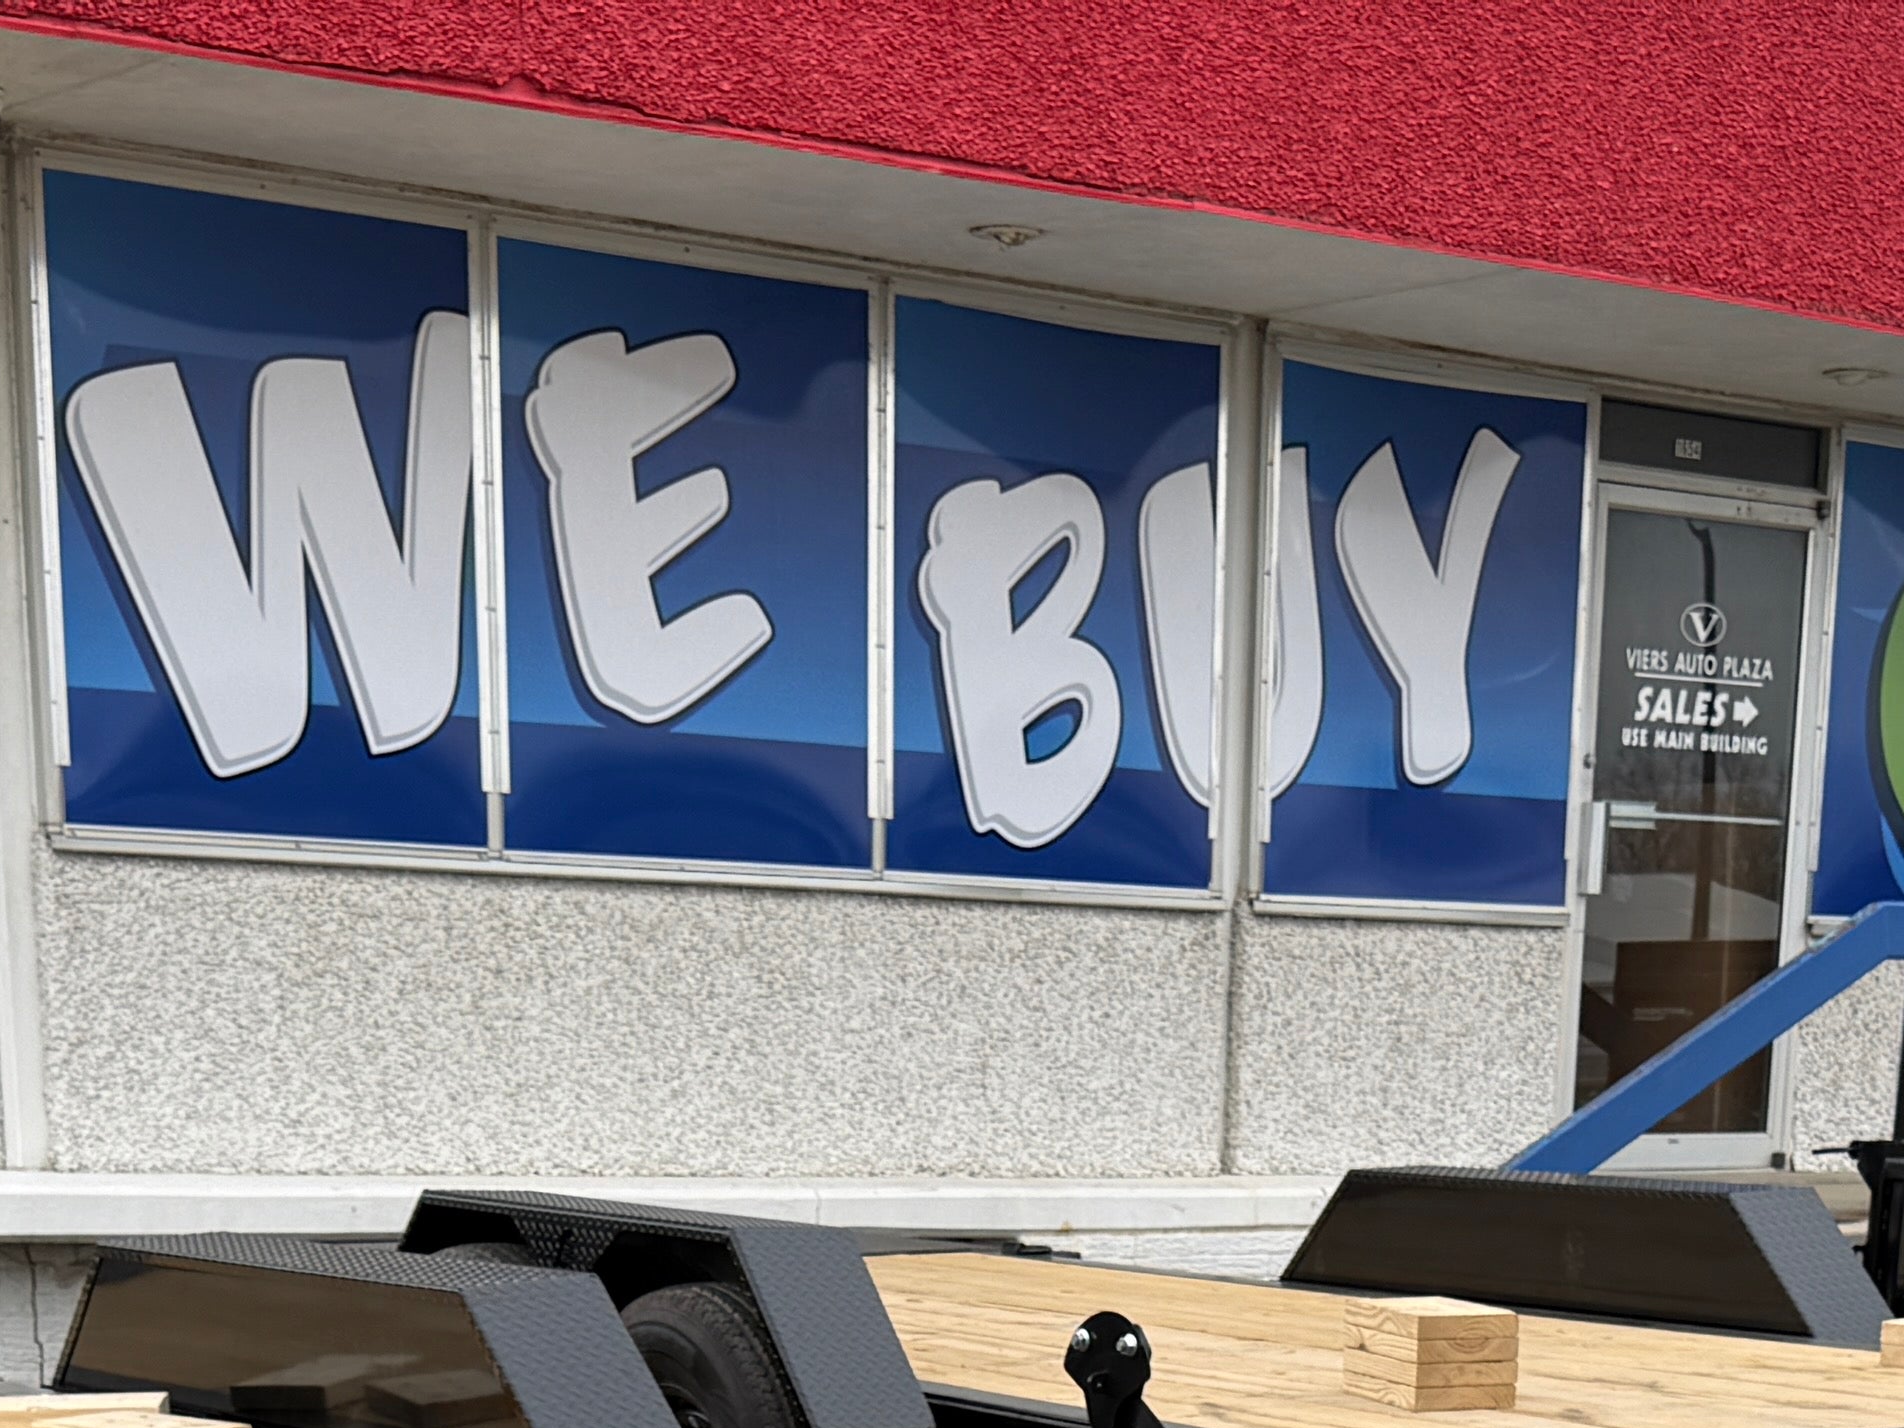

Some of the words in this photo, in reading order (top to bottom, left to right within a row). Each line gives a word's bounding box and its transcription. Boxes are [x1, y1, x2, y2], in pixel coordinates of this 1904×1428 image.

[67, 309, 773, 778] WE
[919, 428, 1521, 849] BUY
[1689, 612, 1719, 643] V
[1627, 648, 1669, 671] VIERS
[1674, 652, 1718, 675] AUTO
[1723, 656, 1774, 681] PLAZA
[1634, 686, 1729, 727] SALES
[1622, 727, 1648, 747] USE
[1654, 729, 1694, 750] MAIN
[1700, 733, 1768, 755] BUILDING
